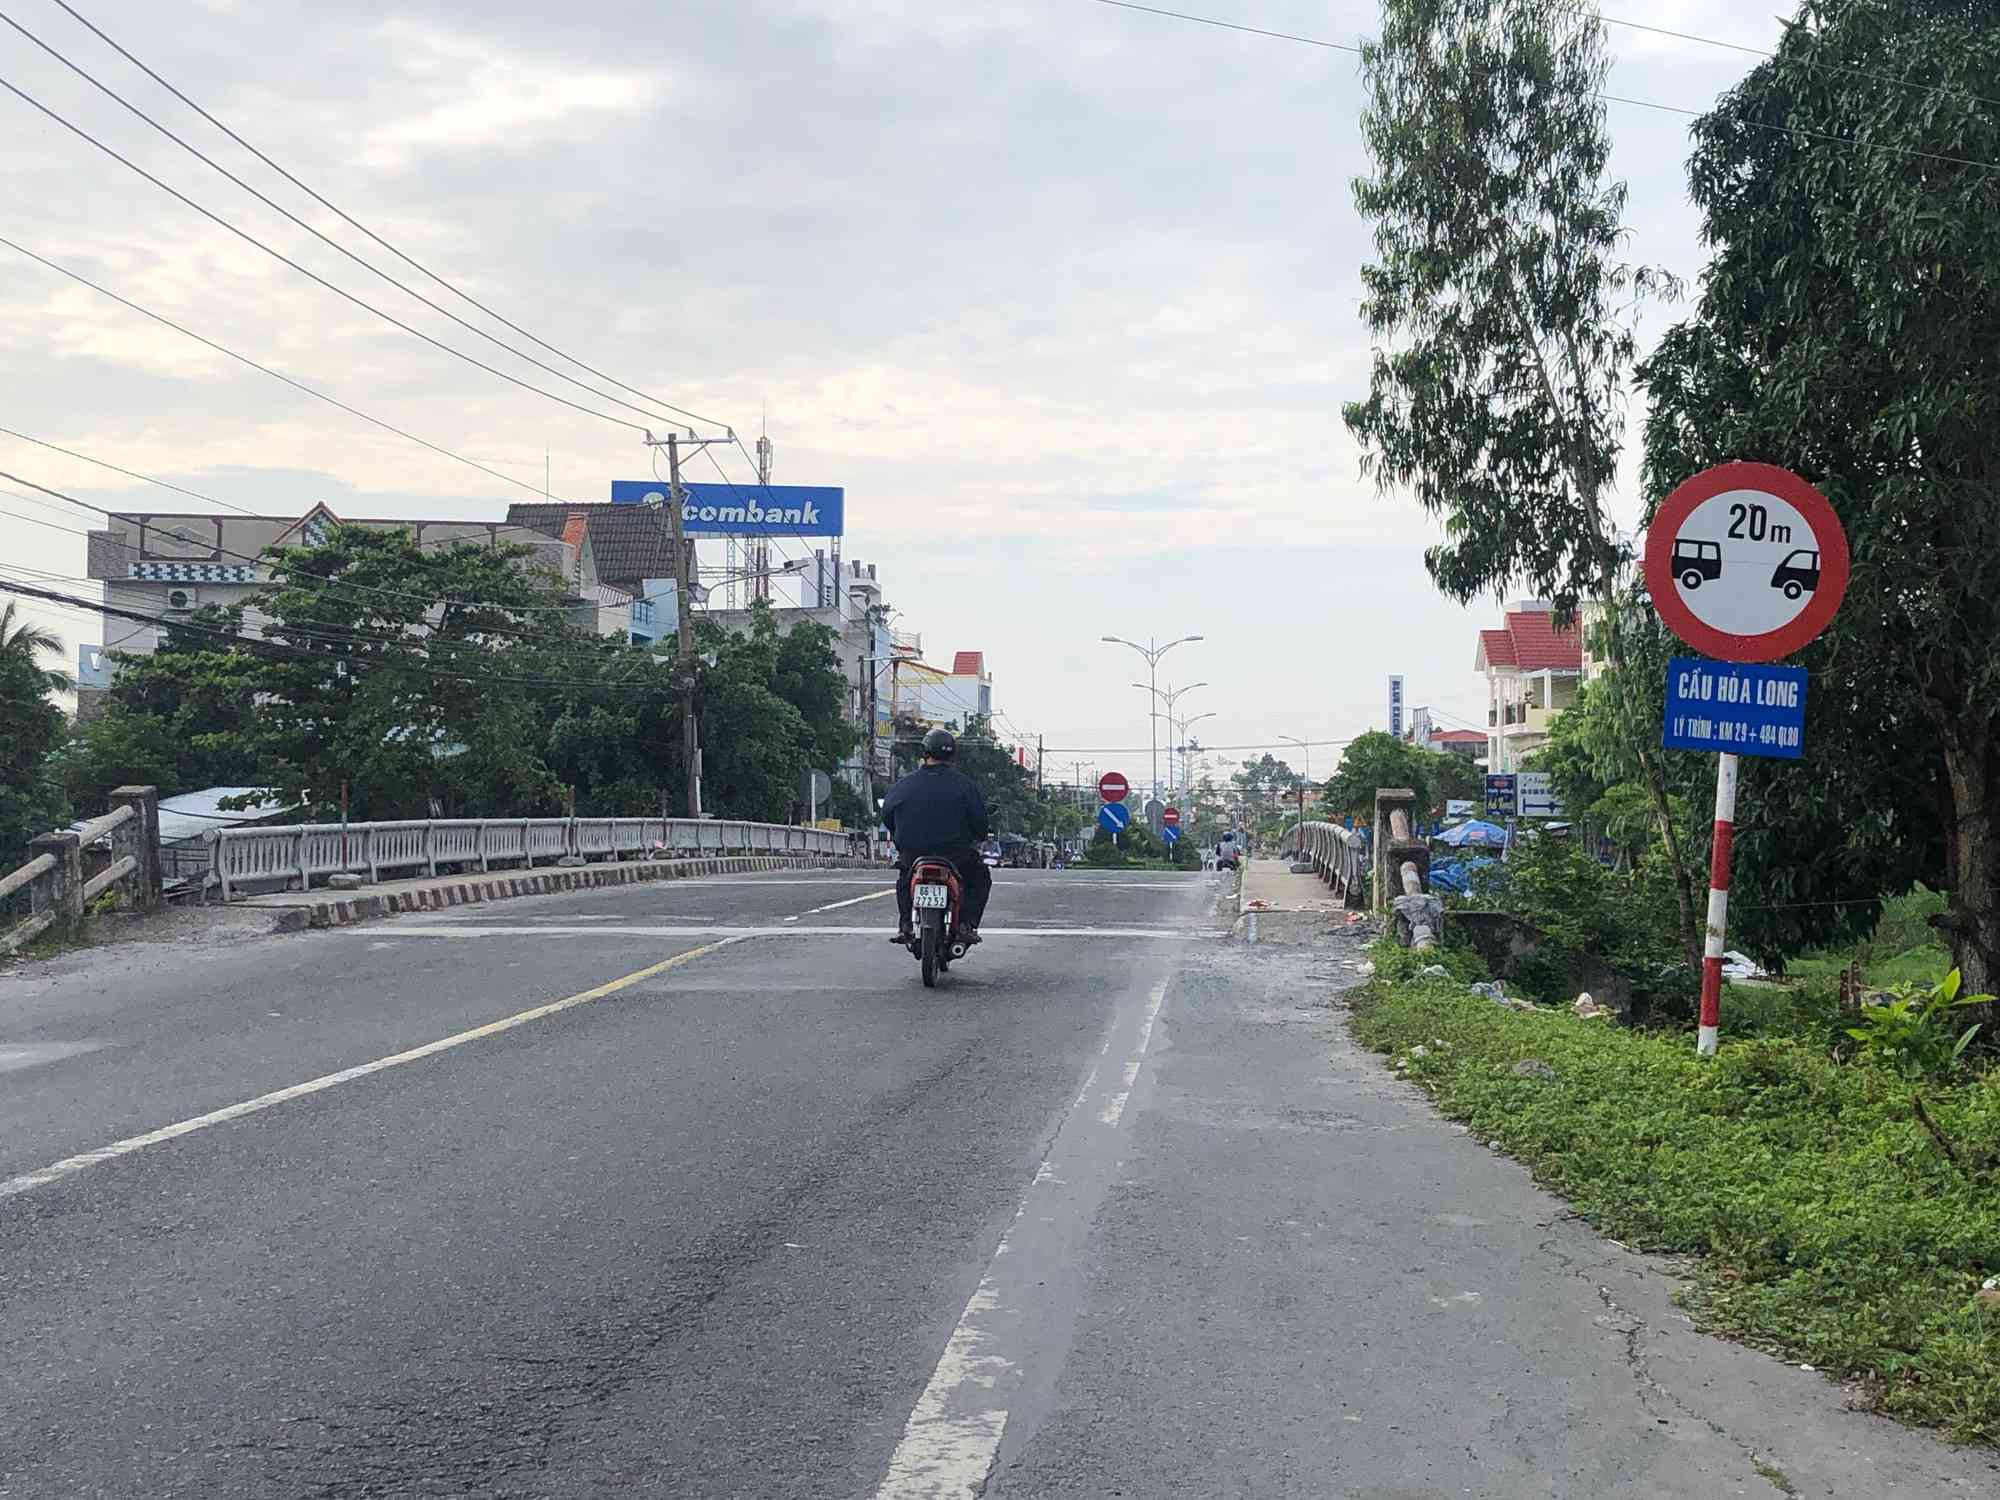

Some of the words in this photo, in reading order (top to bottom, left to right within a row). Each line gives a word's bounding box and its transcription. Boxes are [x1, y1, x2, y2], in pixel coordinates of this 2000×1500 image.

[1678, 667, 1713, 700] CẦU
[1717, 671, 1751, 704] HÒA
[1757, 679, 1798, 707] LONG
[1778, 726, 1799, 748] QL80
